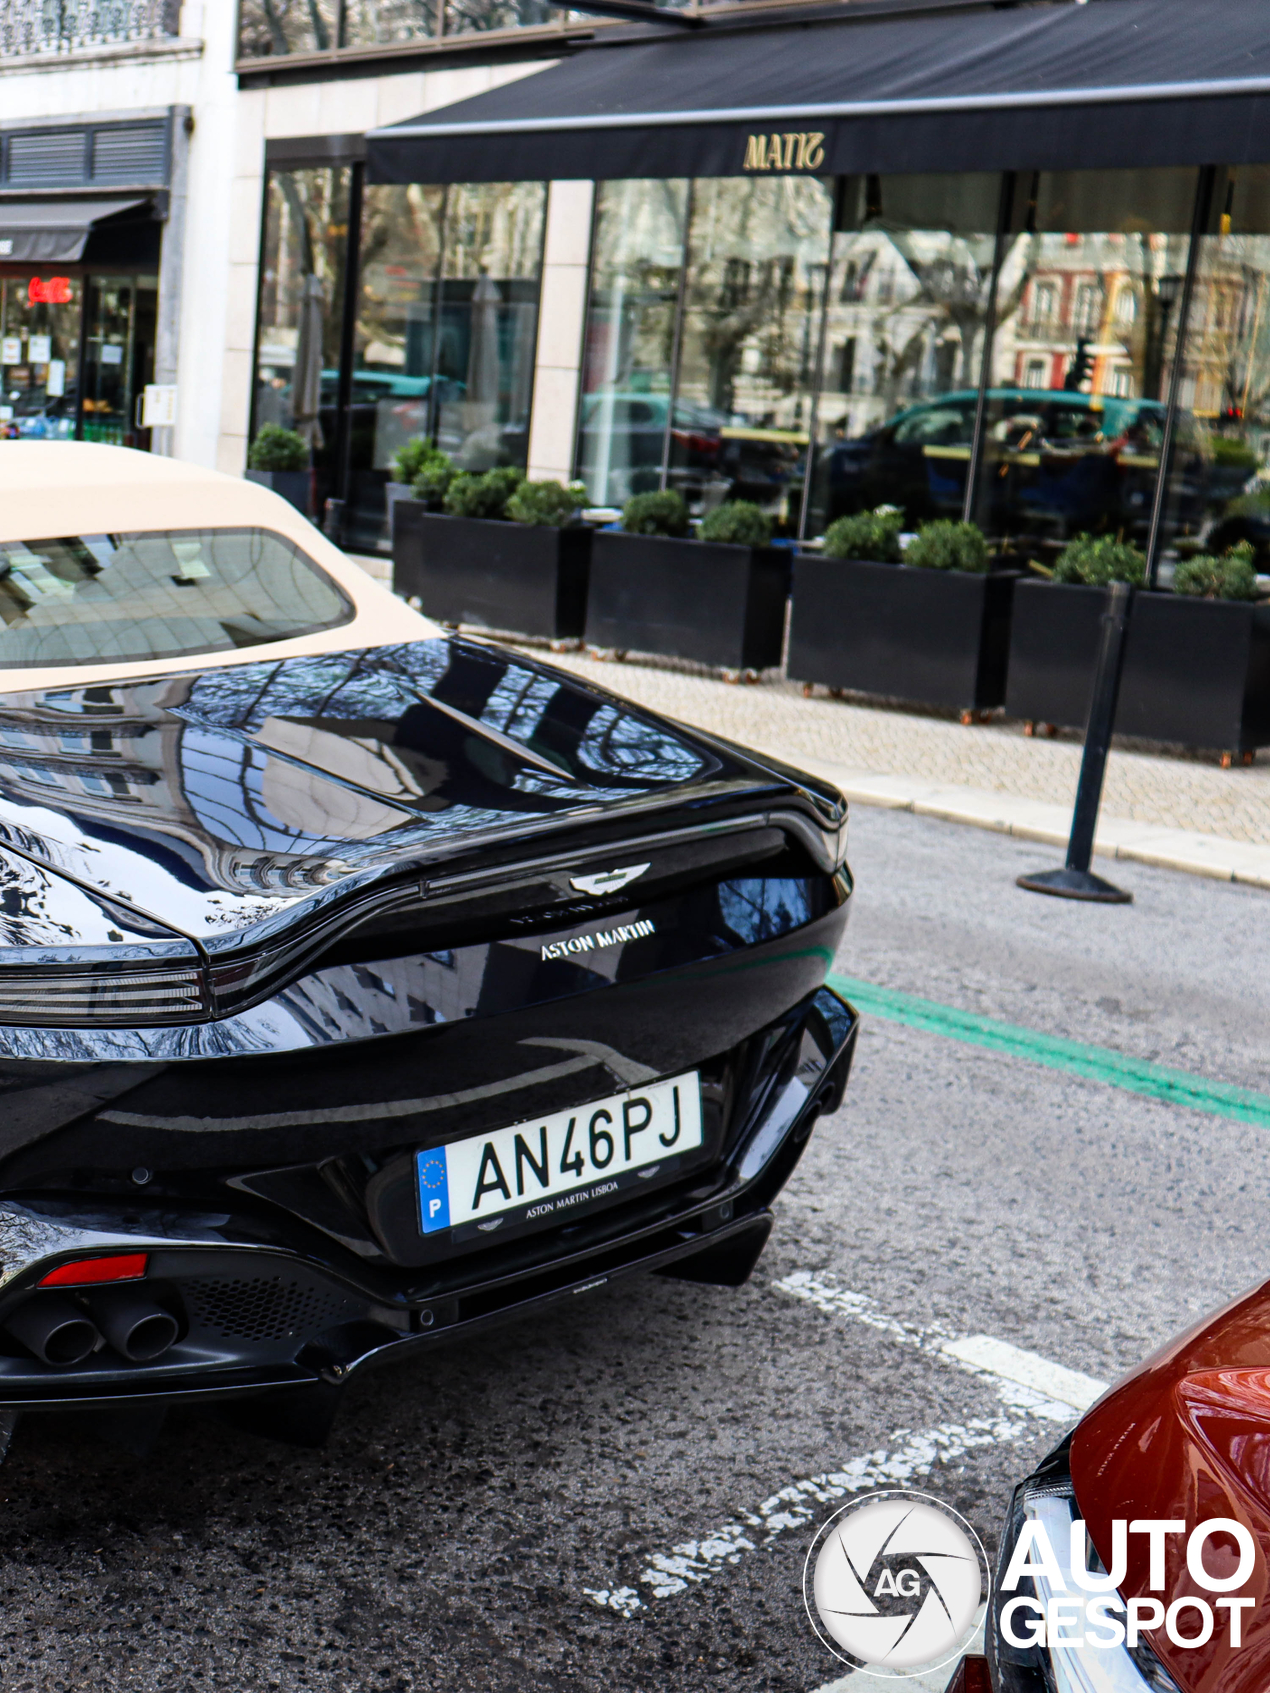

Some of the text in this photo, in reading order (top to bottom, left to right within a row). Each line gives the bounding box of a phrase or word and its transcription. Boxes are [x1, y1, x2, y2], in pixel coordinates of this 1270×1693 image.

[541, 919, 655, 961] ASTON MARTIN
[471, 1085, 681, 1210] AN46PJ
[429, 1198, 442, 1218] P
[526, 1181, 619, 1219] ASTON MARTIN LISBOA
